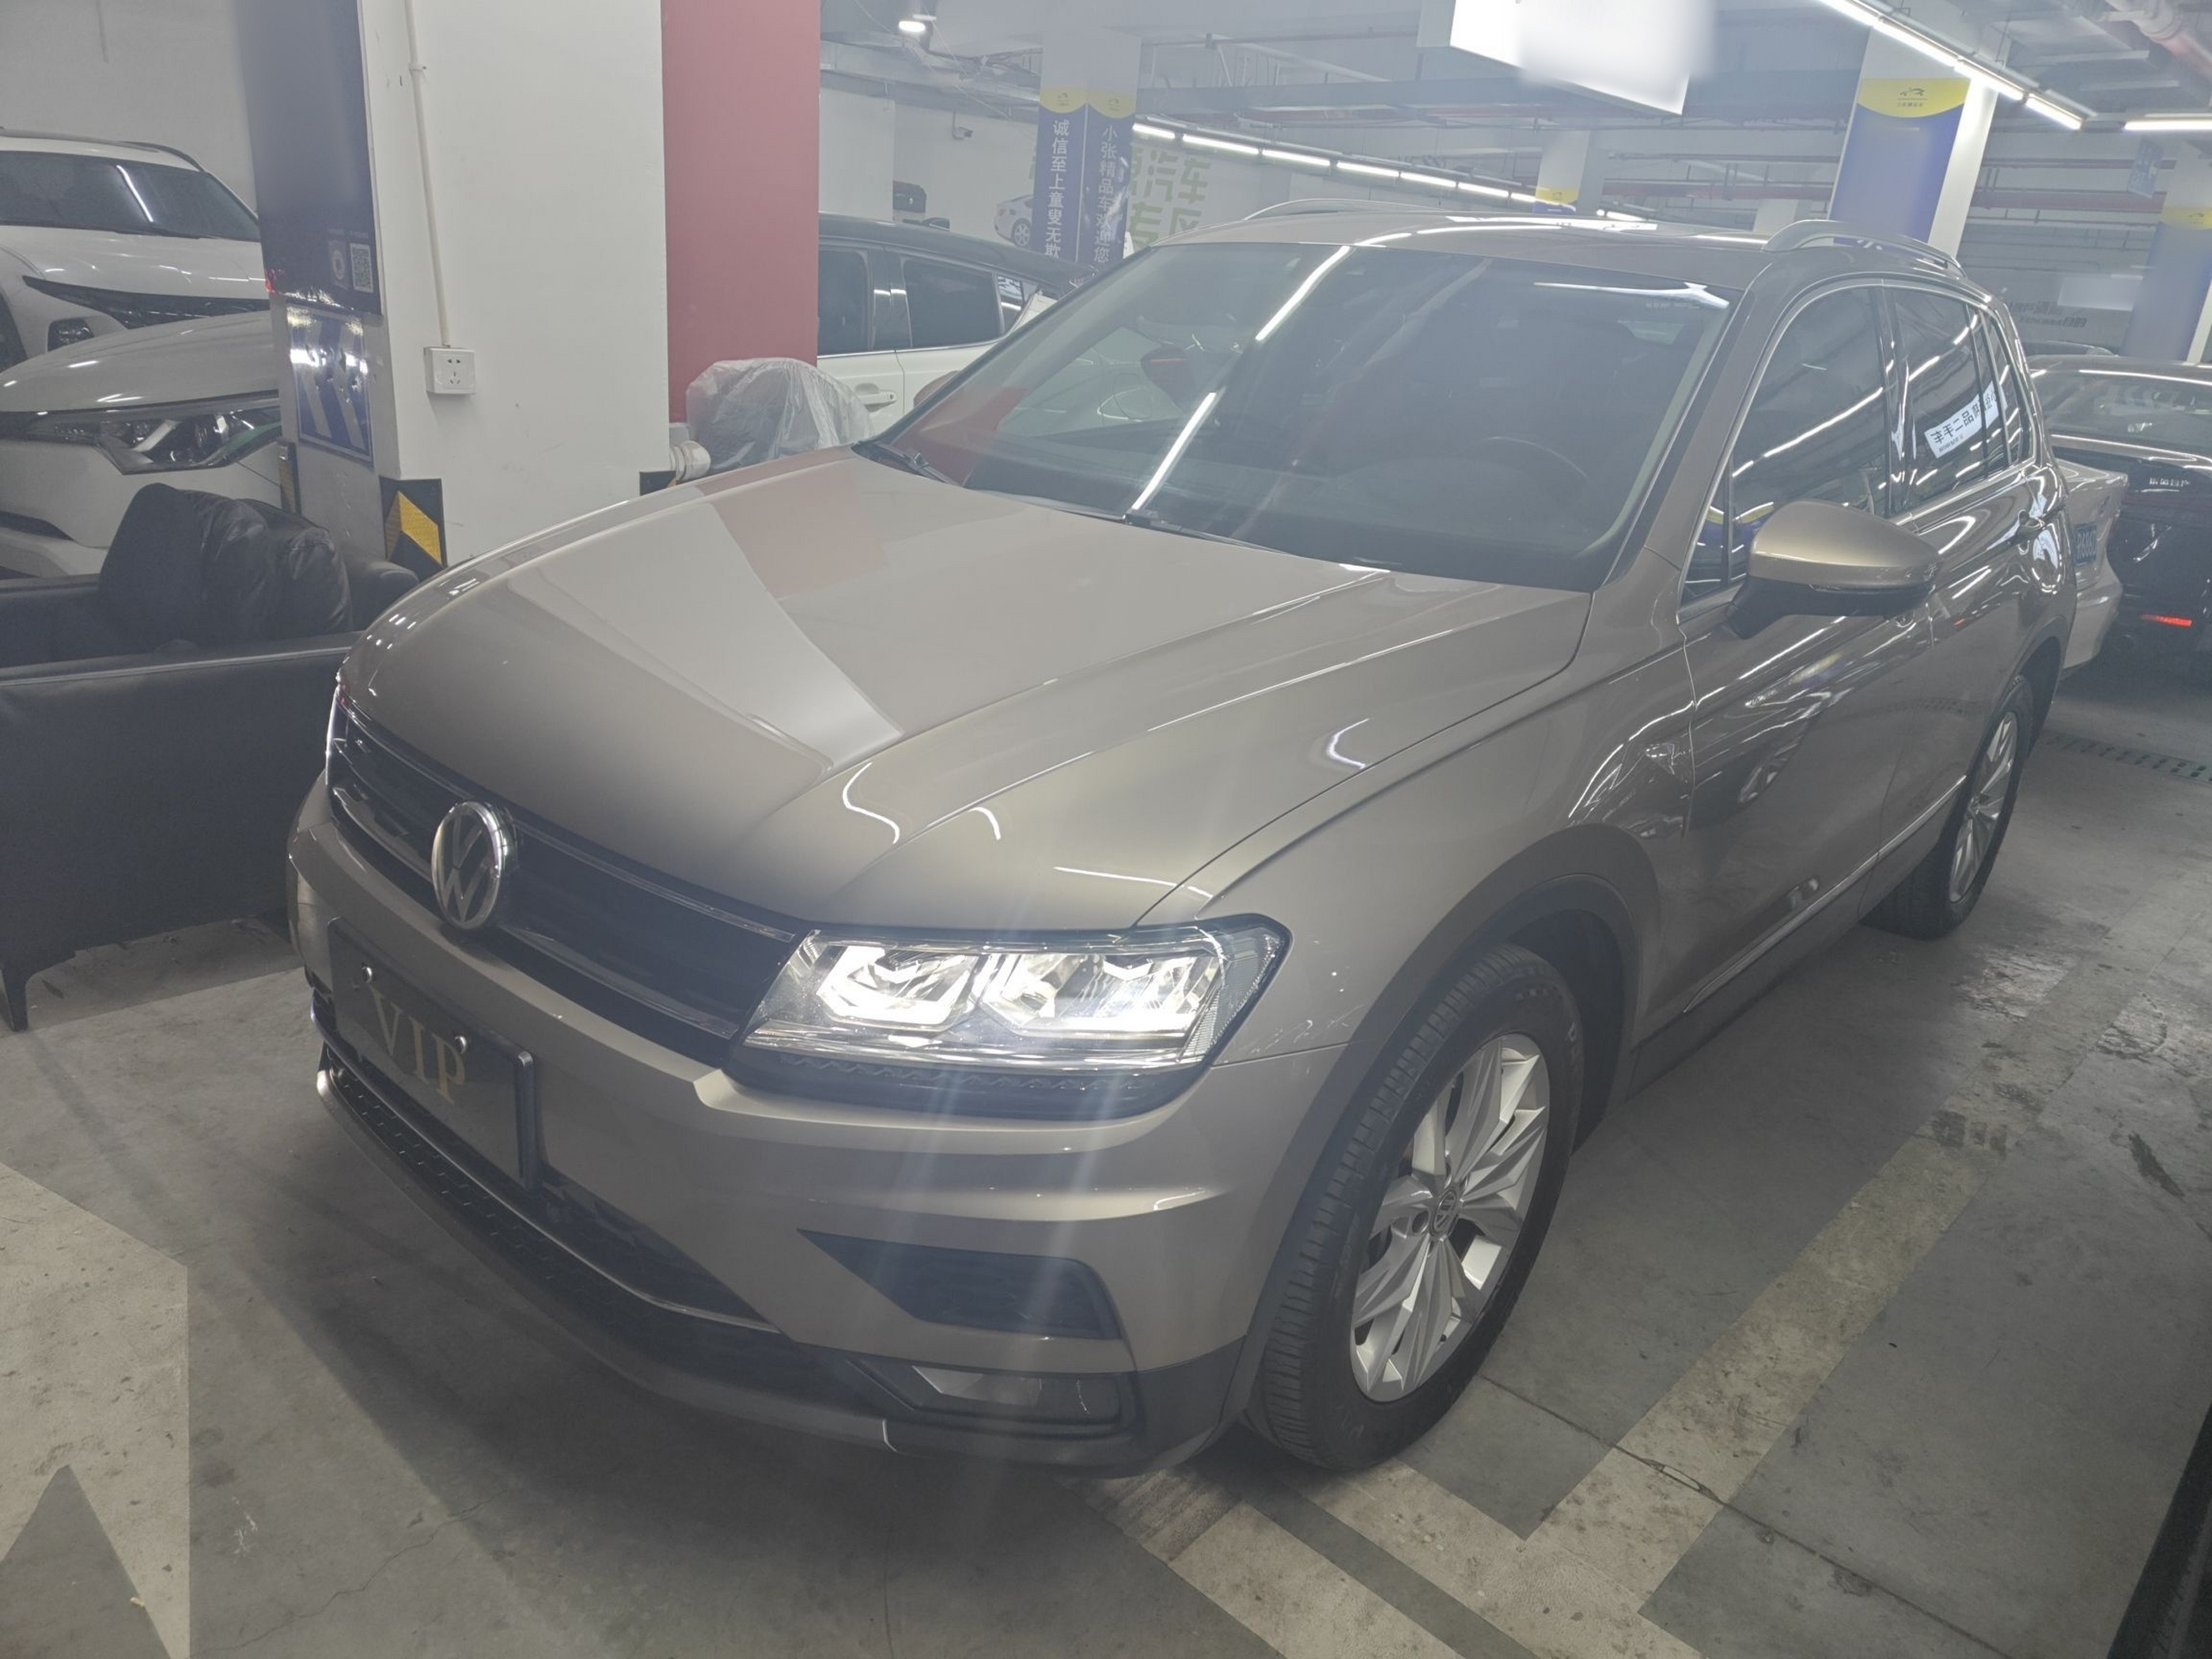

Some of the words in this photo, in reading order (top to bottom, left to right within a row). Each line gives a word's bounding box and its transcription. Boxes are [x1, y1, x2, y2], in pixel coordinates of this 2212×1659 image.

[1044, 119, 1069, 259] 诚信至上童叟无欺
[1094, 125, 1119, 263] 小张精品车欢迎您
[369, 983, 466, 1105] VIP
